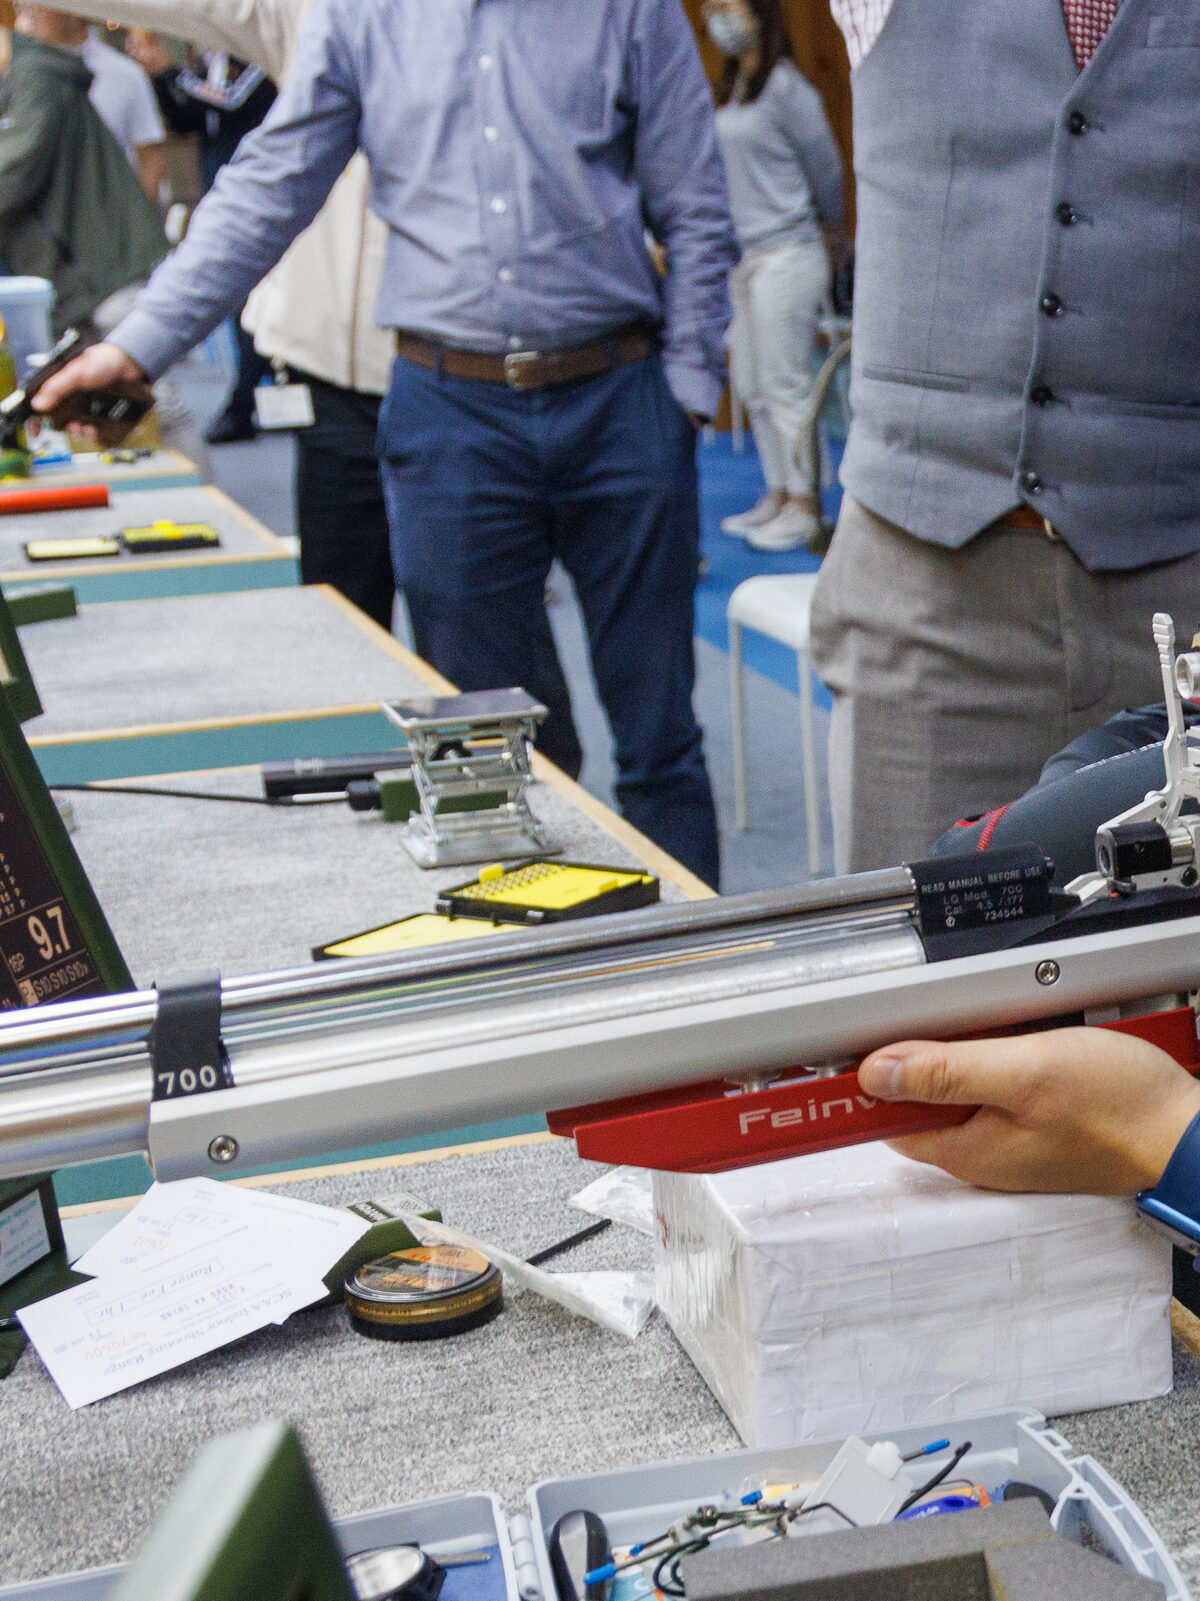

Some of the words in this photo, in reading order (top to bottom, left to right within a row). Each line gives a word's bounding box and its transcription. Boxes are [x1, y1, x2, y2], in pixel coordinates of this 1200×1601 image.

[921, 882, 945, 894] READ
[948, 876, 983, 888] MANUAL
[988, 869, 1021, 882] BEFORE
[1025, 866, 1042, 877] USE
[1001, 884, 1024, 895] 700
[27, 905, 70, 961] 9.7
[158, 1065, 217, 1096] 700
[168, 1260, 213, 1289] Range
[140, 1284, 166, 1302] Fee
[206, 1307, 249, 1332] Indoor
[144, 1324, 205, 1359] Shooting
[101, 1351, 144, 1377] Range
